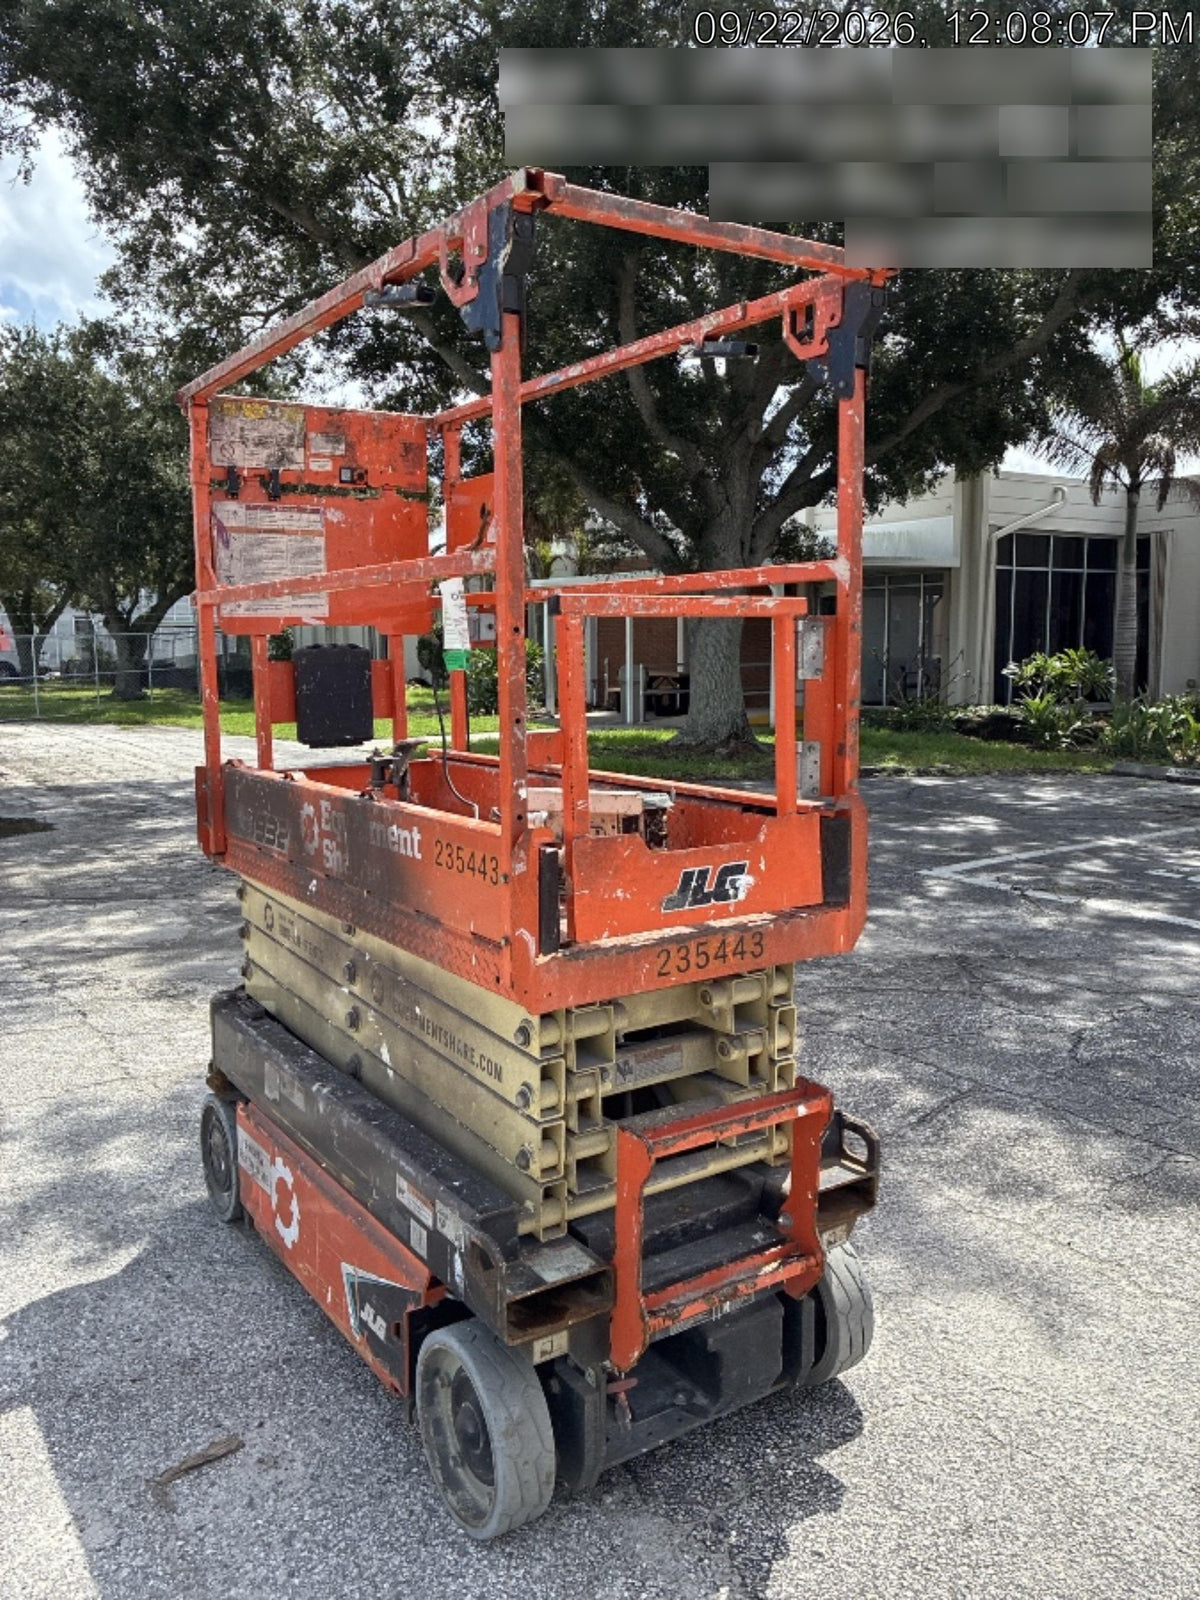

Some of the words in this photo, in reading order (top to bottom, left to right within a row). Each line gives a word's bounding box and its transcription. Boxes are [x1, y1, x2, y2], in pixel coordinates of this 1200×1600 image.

[435, 839, 499, 886] 235443
[661, 860, 752, 913] JLG
[656, 931, 764, 977] 235443
